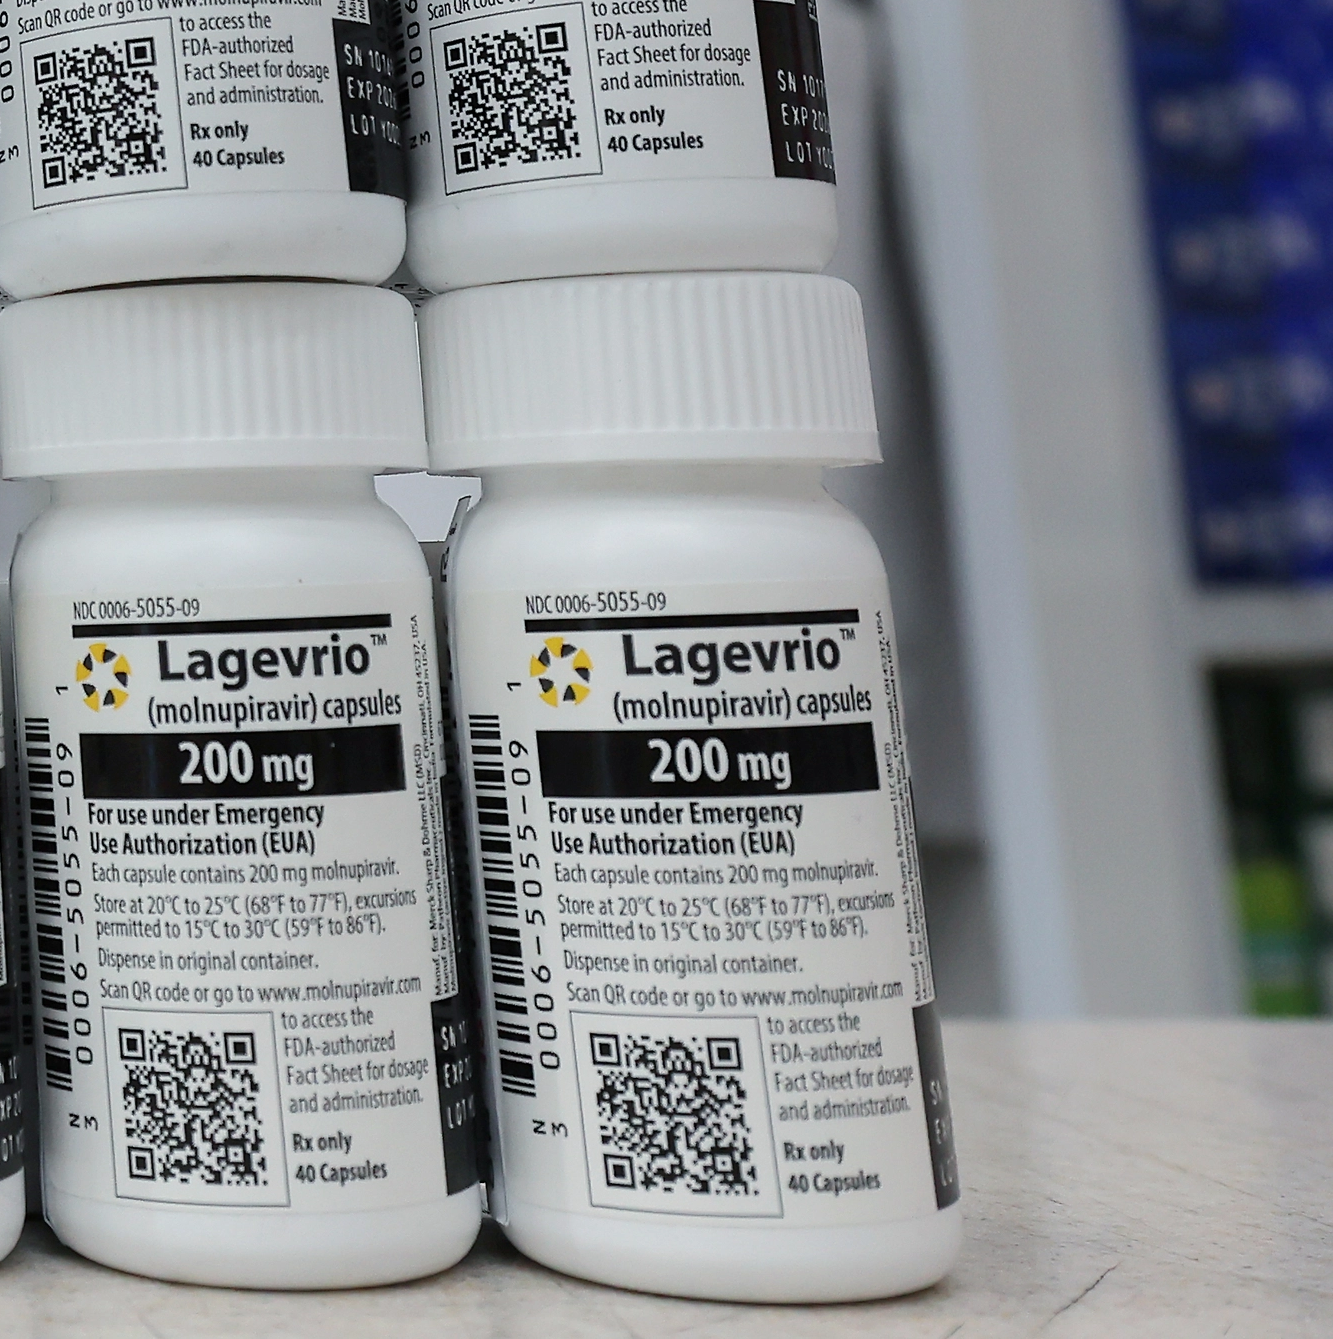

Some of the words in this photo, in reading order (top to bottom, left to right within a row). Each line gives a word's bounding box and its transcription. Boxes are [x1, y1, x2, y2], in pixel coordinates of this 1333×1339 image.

[18, 16, 43, 34] Scan
[44, 9, 63, 30] QR
[64, 4, 96, 25] code
[99, 1, 112, 16] or
[190, 123, 212, 141] Rx
[216, 120, 249, 141] only
[193, 150, 212, 168] 40
[217, 148, 285, 168] Capsules
[73, 602, 95, 620] NDC
[98, 599, 200, 619] 0006-5055-09
[525, 595, 553, 614] NDC
[555, 591, 666, 614] 0006-5055-09
[148, 692, 317, 728] (molnupiravir)
[323, 689, 401, 724] capsules
[613, 690, 791, 725] (molnupiravir)
[797, 685, 871, 719] capsules
[179, 741, 254, 784] 200
[262, 750, 314, 790] mg
[648, 738, 729, 783] 200
[737, 750, 792, 790] mg
[88, 803, 113, 824] For
[116, 806, 147, 825] use
[152, 802, 209, 824] under
[215, 800, 324, 826] Emergency
[548, 803, 577, 824] For
[581, 805, 615, 824] use
[620, 801, 683, 824] under
[689, 800, 803, 826] Emergency
[90, 833, 119, 854] Use
[123, 831, 256, 856] Authorization
[262, 829, 315, 855] (EUA)
[551, 832, 585, 854] Use
[589, 830, 734, 856] Authorization
[740, 829, 795, 855] (EUA)
